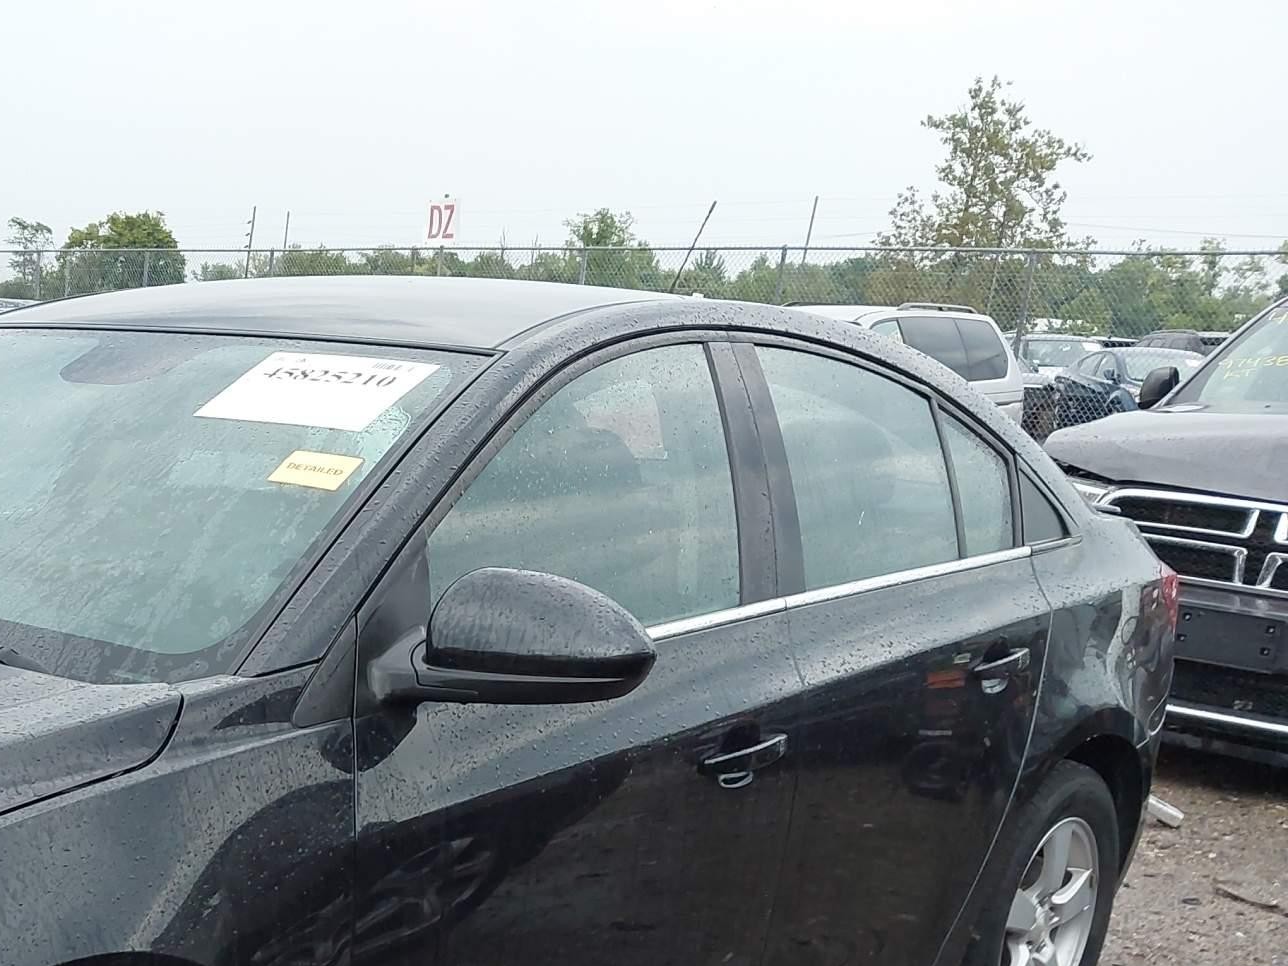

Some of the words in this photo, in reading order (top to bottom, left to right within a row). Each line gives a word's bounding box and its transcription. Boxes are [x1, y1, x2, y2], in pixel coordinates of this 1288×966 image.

[427, 203, 455, 239] DZ
[263, 367, 398, 388] 45825210
[286, 462, 344, 477] DETAILED
